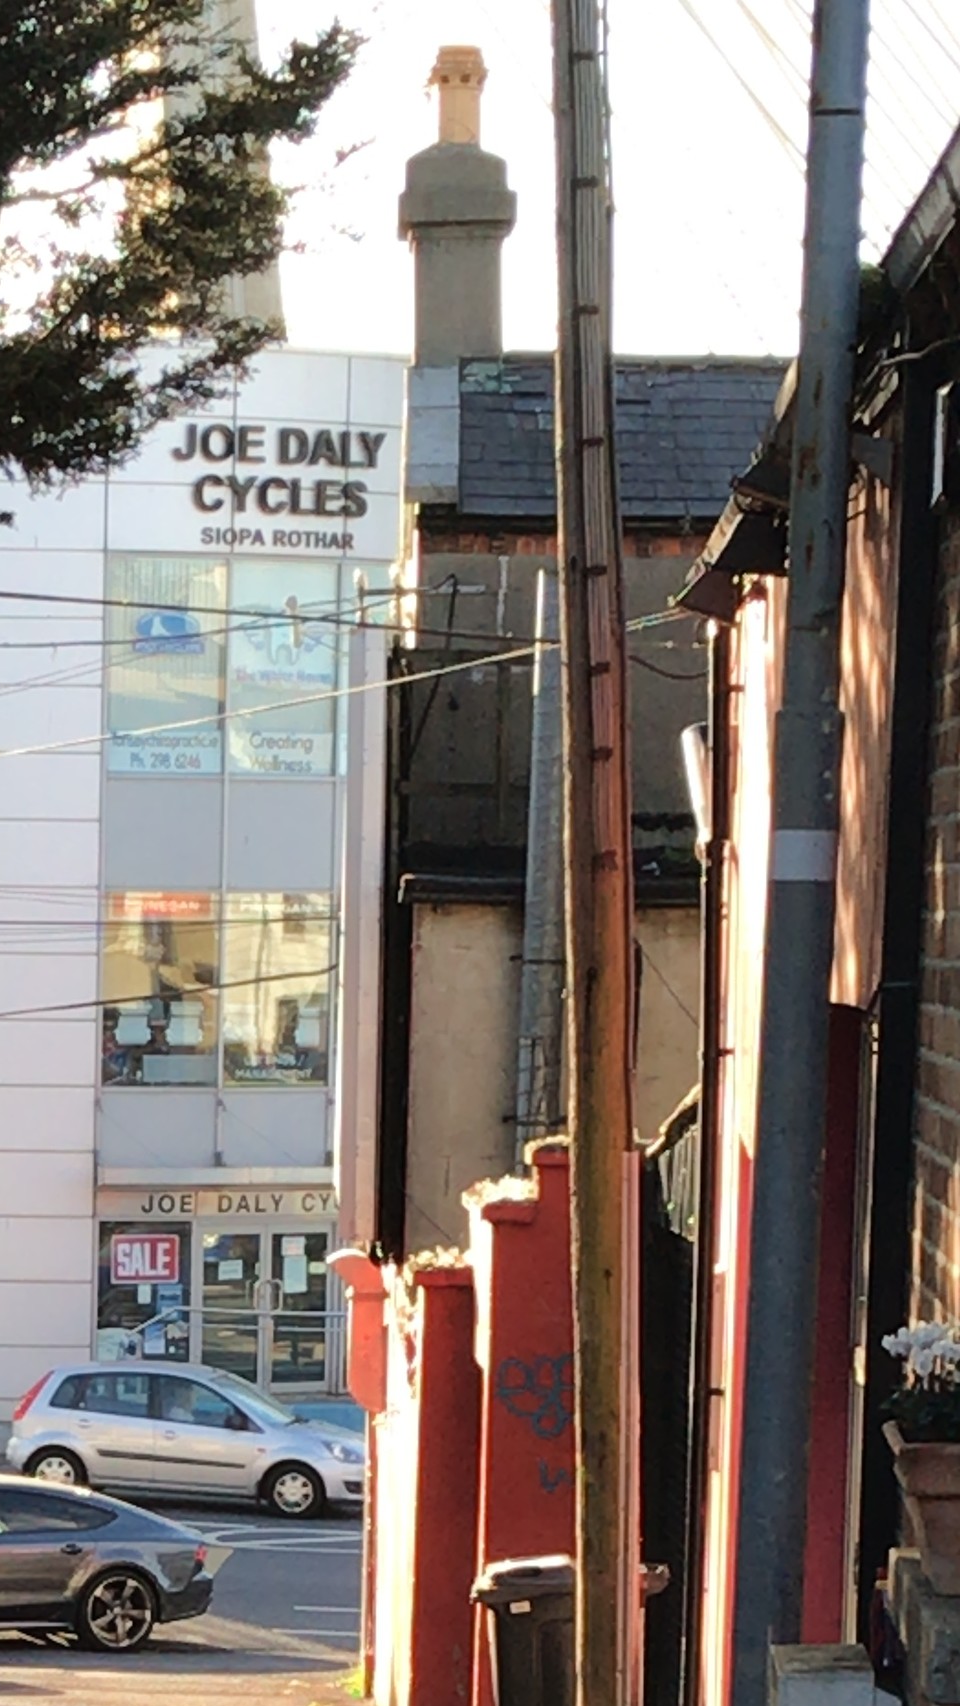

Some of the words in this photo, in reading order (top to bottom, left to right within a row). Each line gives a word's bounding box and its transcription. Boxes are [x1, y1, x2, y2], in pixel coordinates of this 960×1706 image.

[171, 423, 266, 463] JOE
[277, 427, 387, 468] DALY
[193, 474, 368, 518] CYCLES
[200, 527, 265, 546] SIOPA
[272, 530, 354, 549] ROTHAR
[249, 730, 314, 754] Creating
[248, 755, 312, 772] Wellness
[141, 1194, 193, 1214] JOE
[218, 1194, 284, 1213] DALY
[116, 1241, 171, 1277] SALE
